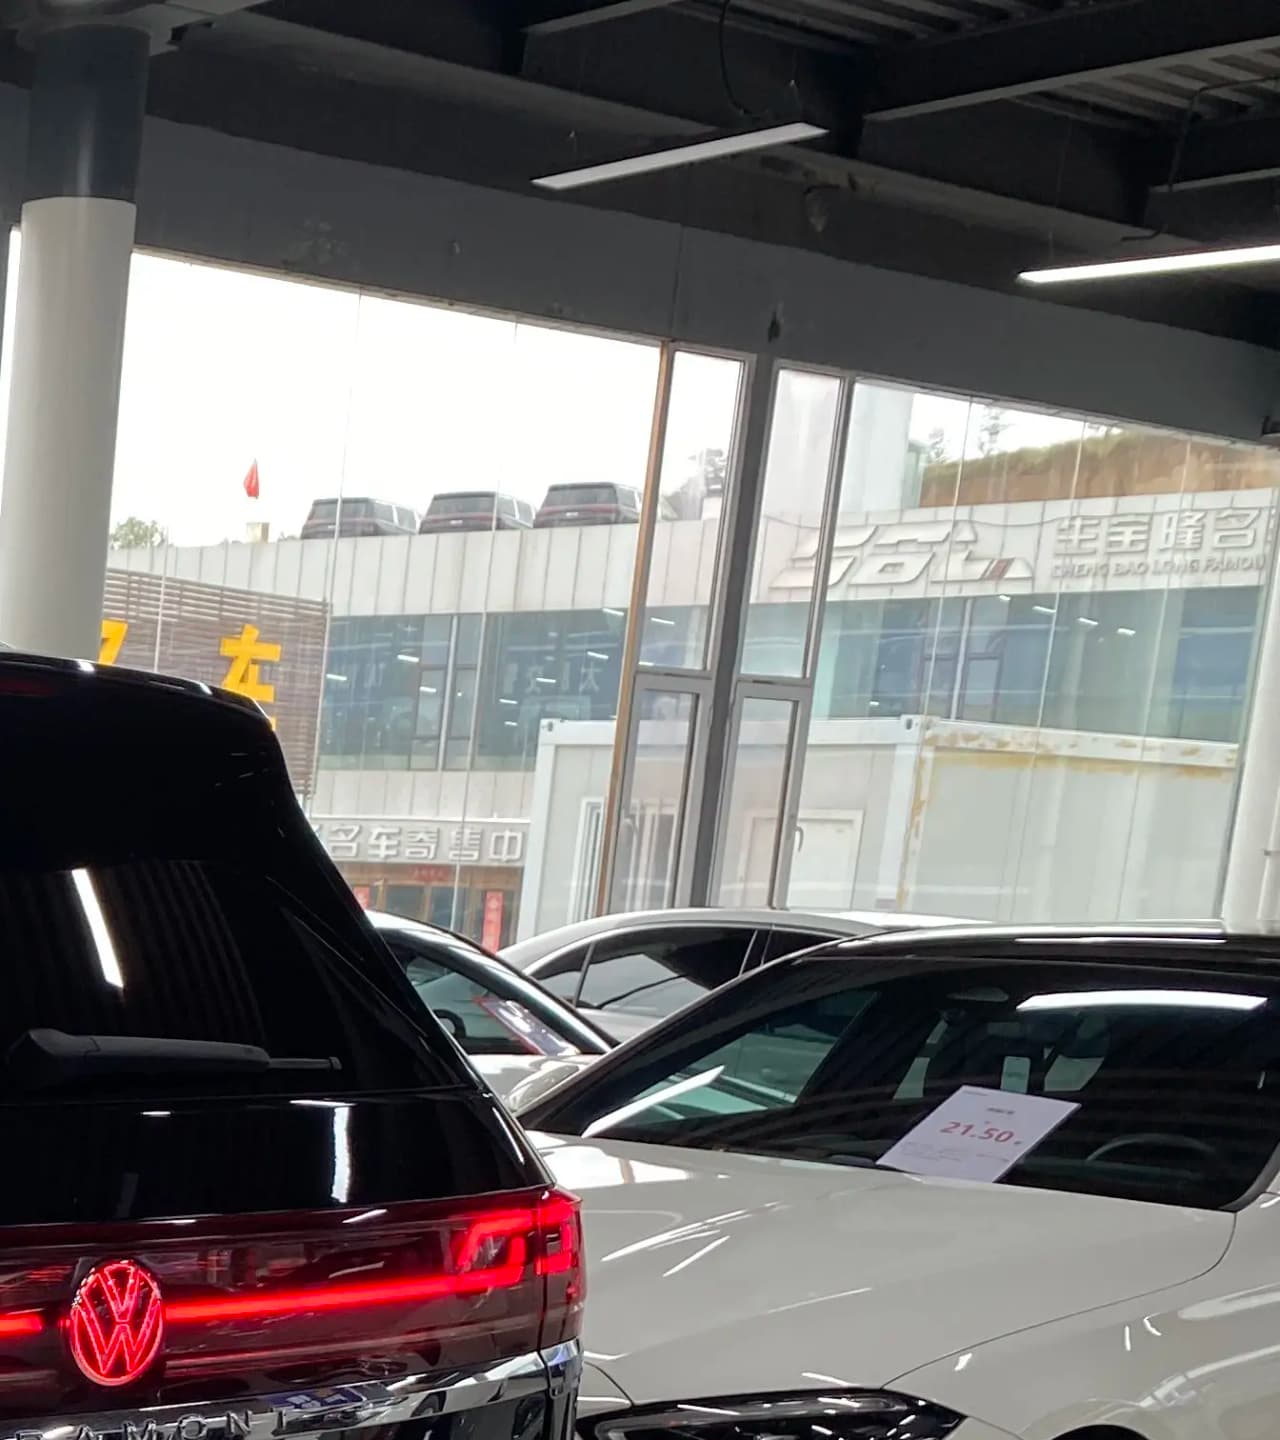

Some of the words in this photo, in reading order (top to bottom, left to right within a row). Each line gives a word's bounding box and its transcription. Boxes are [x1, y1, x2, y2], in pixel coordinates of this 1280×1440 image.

[1202, 553, 1265, 574] FAMOU
[313, 824, 524, 863] 名车寄售中
[940, 1120, 1015, 1143] 21.50
